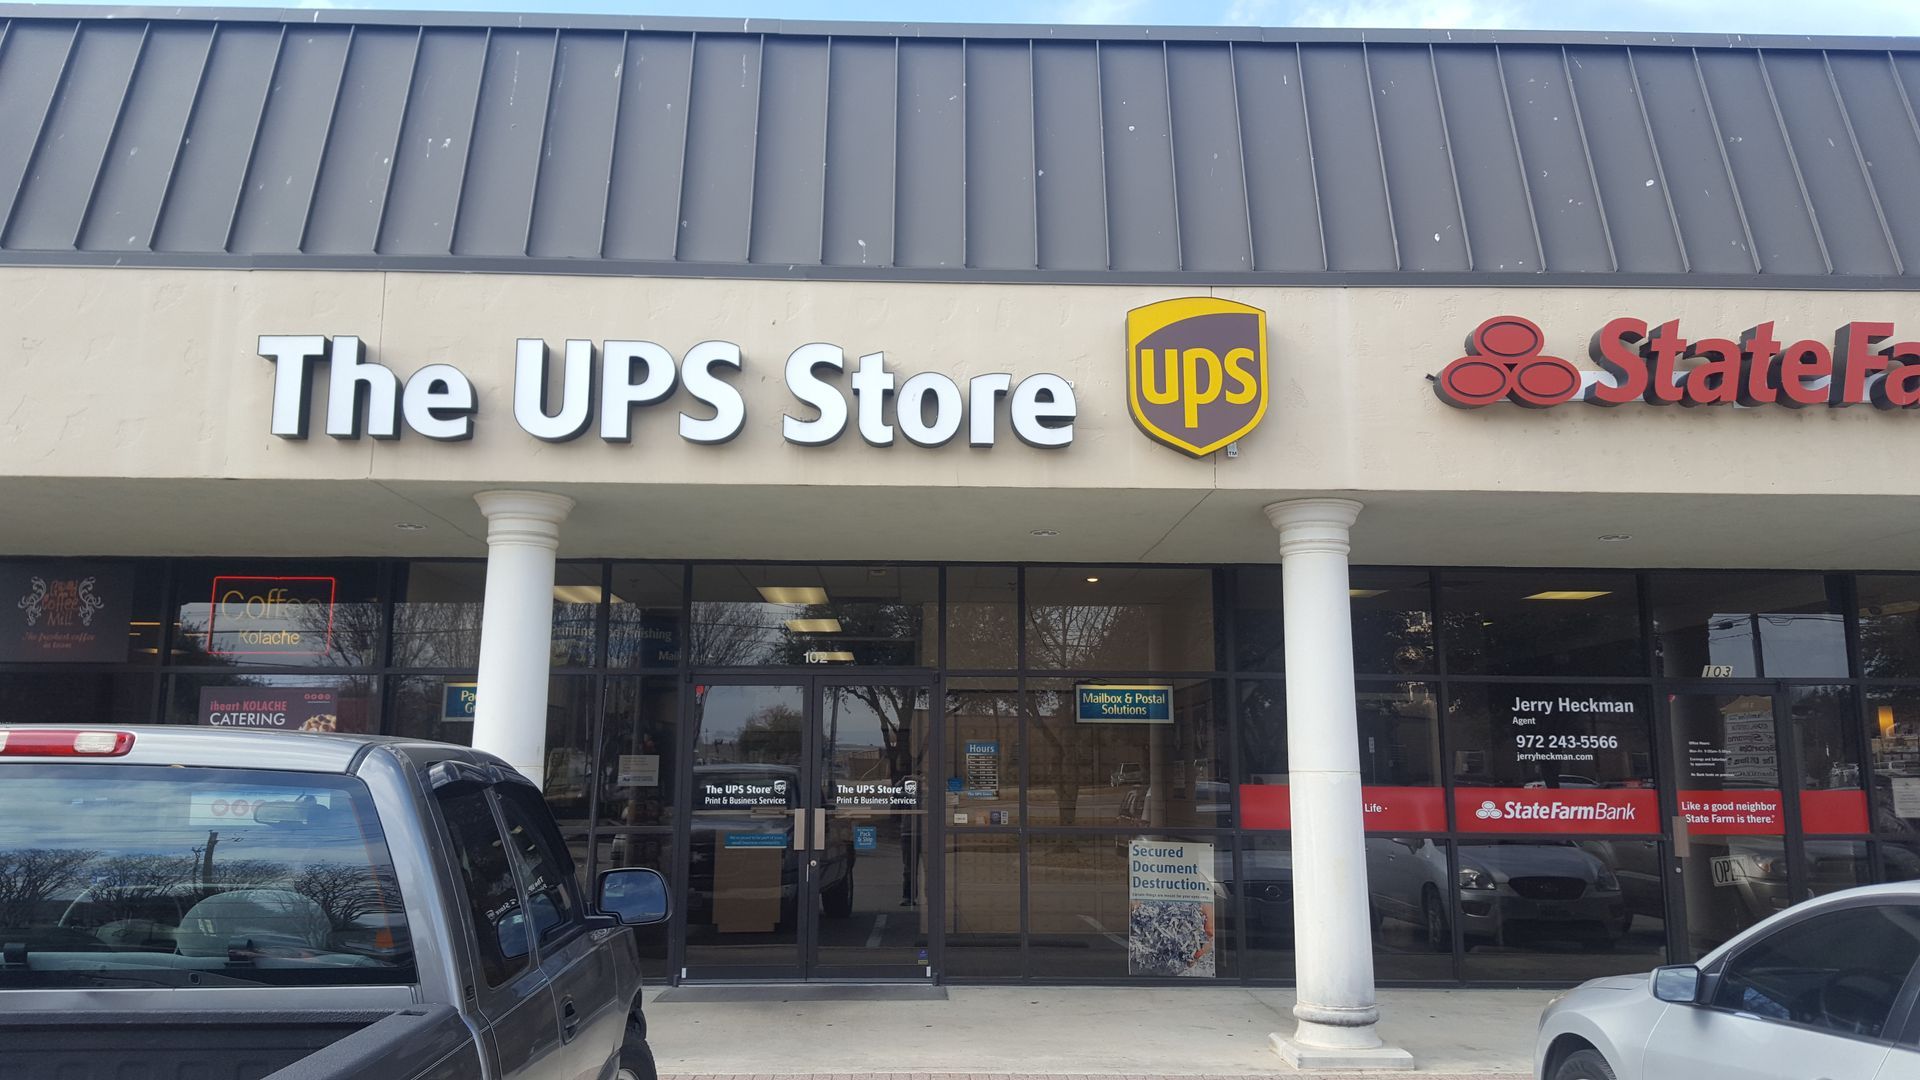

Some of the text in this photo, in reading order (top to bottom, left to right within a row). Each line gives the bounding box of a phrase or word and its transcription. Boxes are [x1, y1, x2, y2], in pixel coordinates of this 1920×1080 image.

[257, 334, 1078, 449] The UPS Store
[1140, 347, 1258, 429] ups
[239, 629, 300, 645] Kolache
[803, 651, 828, 664] 102
[1704, 666, 1732, 678] 103
[1082, 692, 1165, 704] Mailbox & Postal
[242, 700, 288, 712] KOLACHE
[1101, 704, 1147, 715] Solutions
[1511, 697, 1634, 715] Jerry Heckman
[209, 712, 286, 726] CATERING
[1512, 716, 1536, 726] Agent
[1516, 734, 1618, 749] 972 243-5566
[969, 744, 995, 753] Hours
[1516, 751, 1593, 762] jerryheckman.com
[706, 785, 772, 794] The UPS Store
[836, 784, 902, 794] The UPS Store
[705, 796, 786, 804] Print & Business Services
[836, 796, 917, 805] Print & Business Services
[1364, 803, 1382, 813] Life
[1681, 801, 1777, 813] Like a good neighbor
[1685, 814, 1709, 823] State
[1711, 814, 1735, 823] Farm
[1737, 814, 1745, 823] is
[1132, 844, 1184, 858] Secured
[1132, 860, 1198, 874] Document
[1132, 876, 1210, 891] Destruction.
